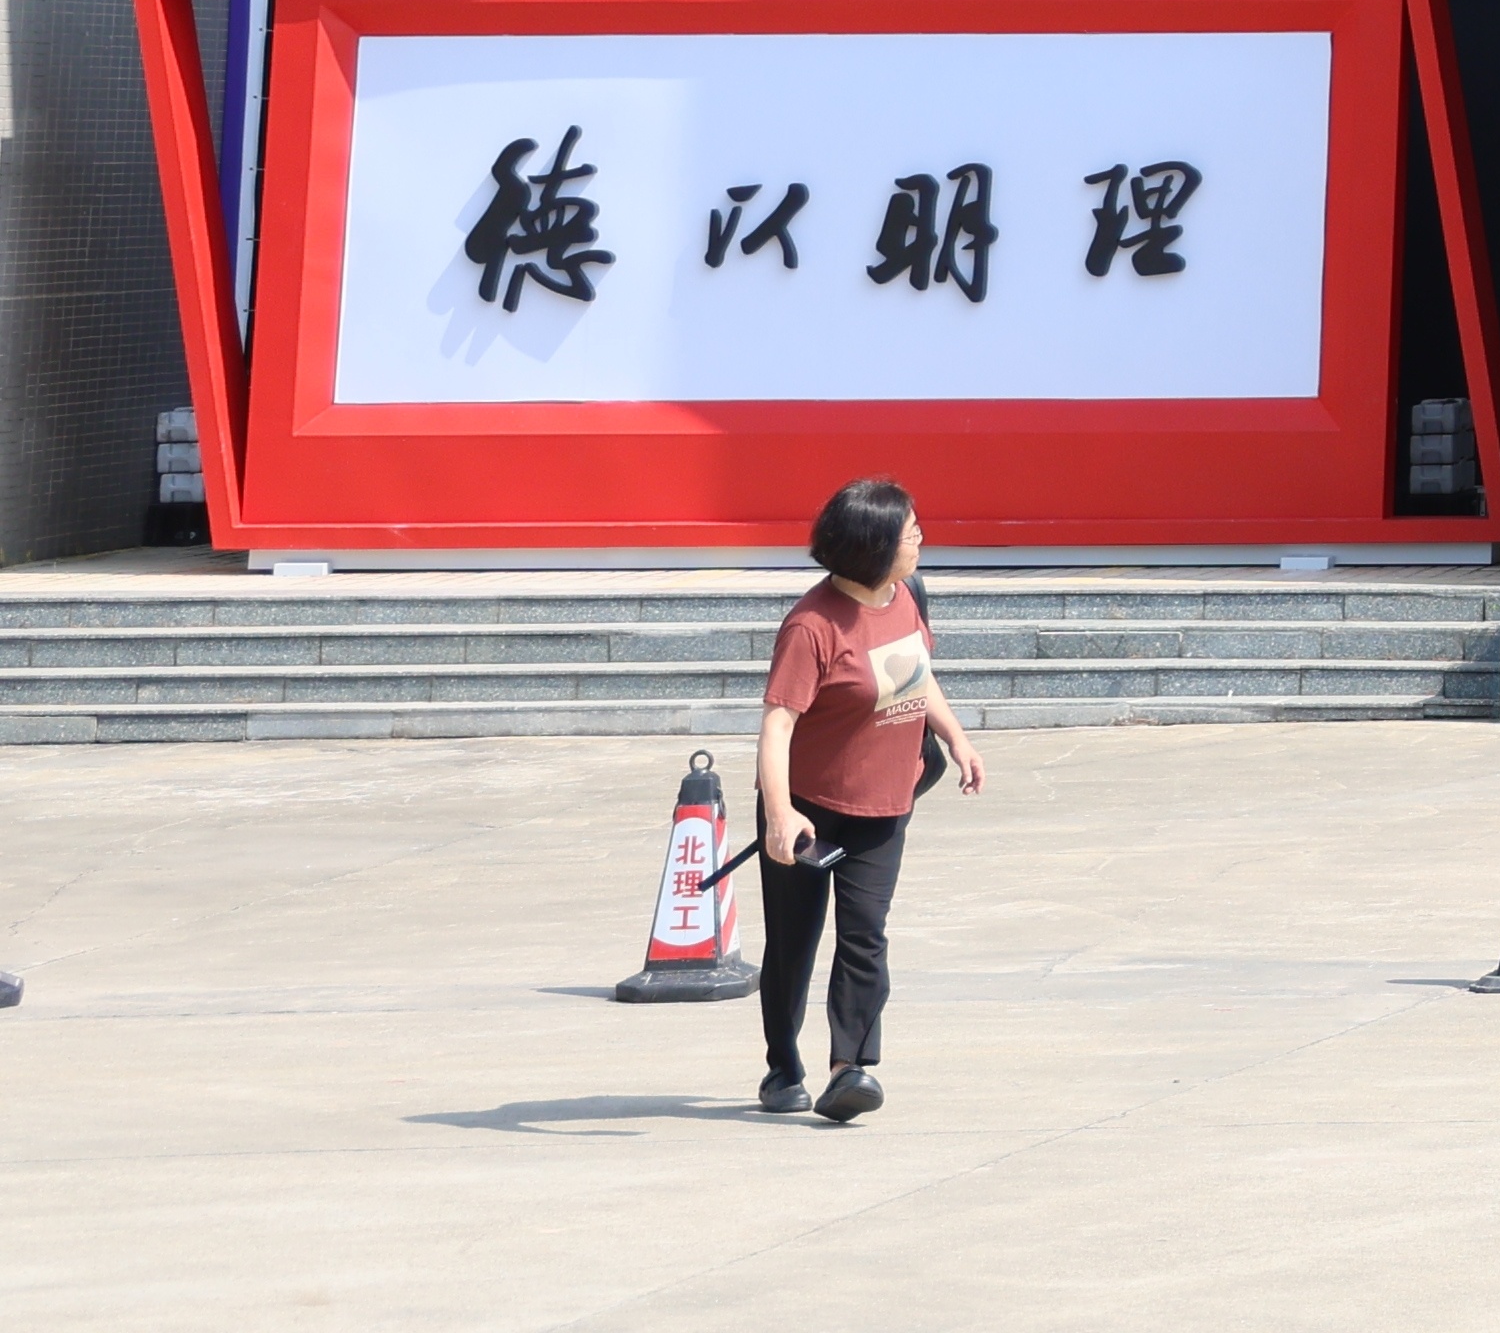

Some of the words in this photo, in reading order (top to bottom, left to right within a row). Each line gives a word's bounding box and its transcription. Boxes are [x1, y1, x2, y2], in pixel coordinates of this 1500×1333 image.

[463, 124, 1203, 313] 德以明理
[669, 835, 705, 931] 北理工
